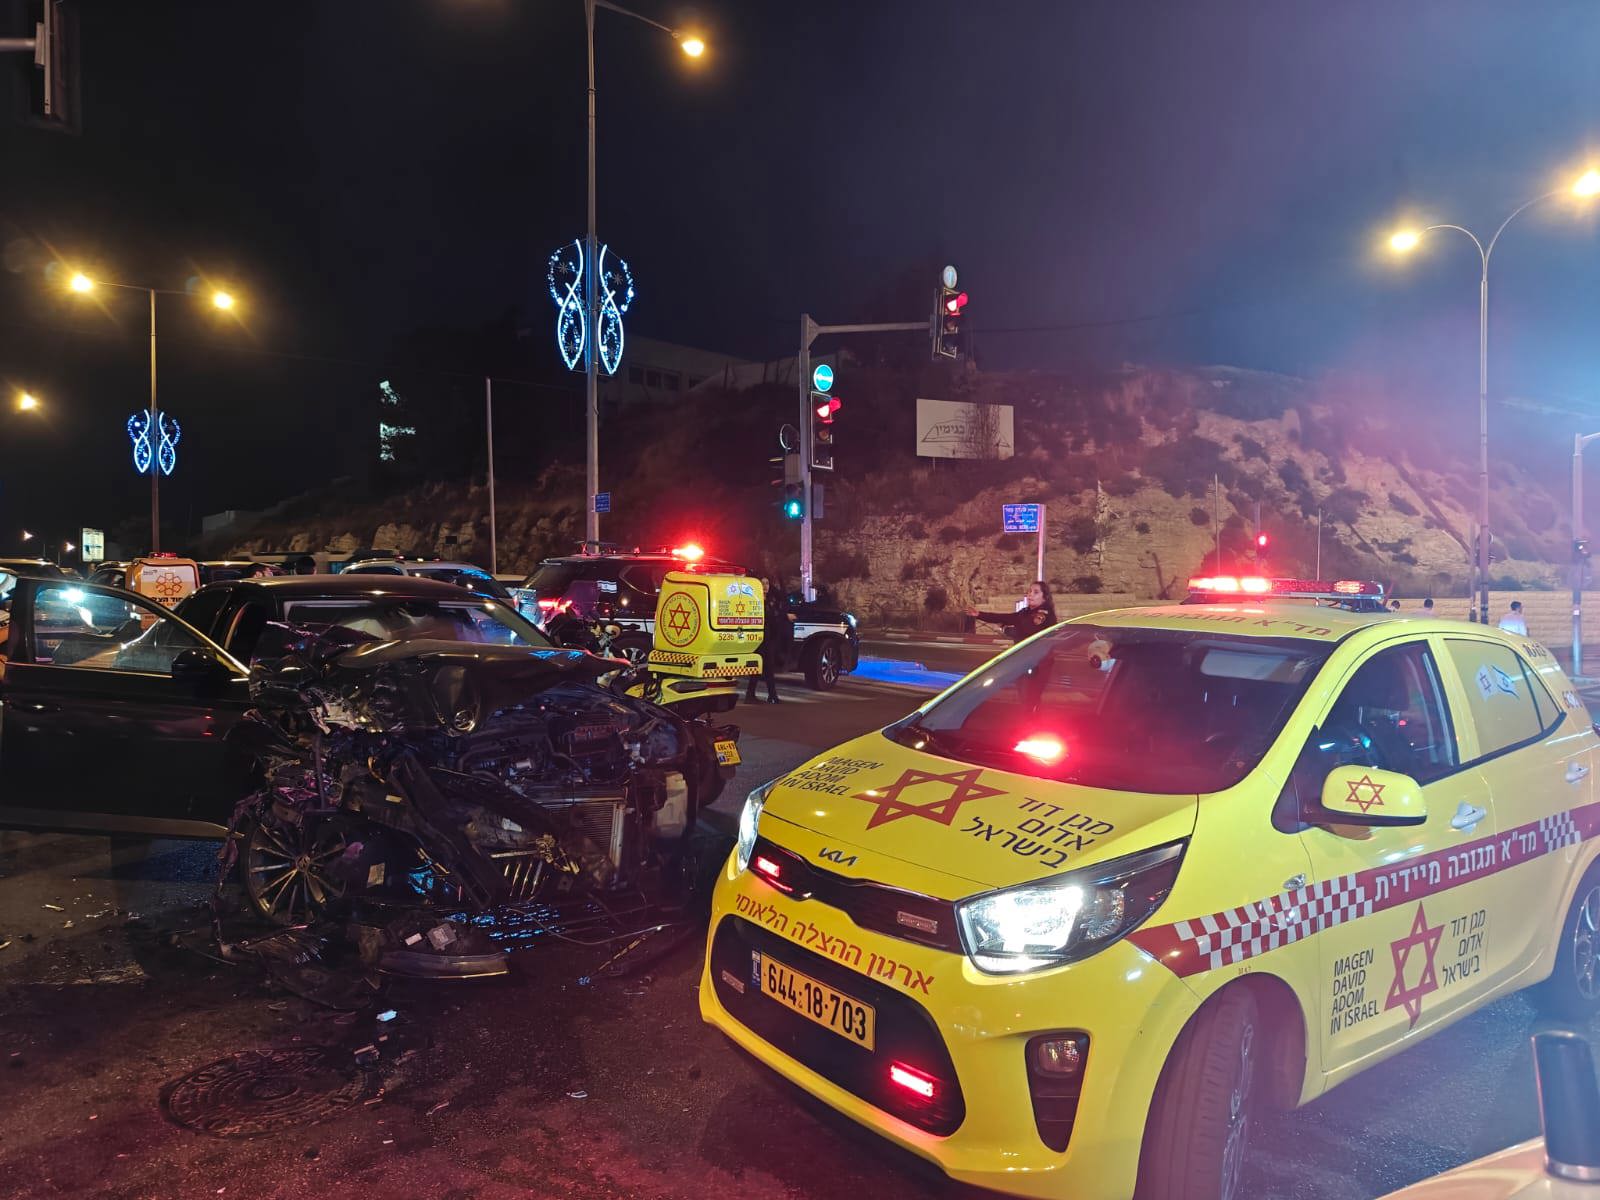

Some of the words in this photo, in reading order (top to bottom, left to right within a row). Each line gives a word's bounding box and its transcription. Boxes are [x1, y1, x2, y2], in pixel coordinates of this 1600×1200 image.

[795, 770, 847, 783] ADOM
[809, 764, 860, 775] DAVID
[827, 756, 884, 769] MAGEN
[779, 777, 802, 788] IN
[798, 780, 851, 796] ISRAEL
[1018, 796, 1064, 818] דוד
[1017, 818, 1096, 851] אדום
[1058, 813, 1115, 835] מגן
[818, 846, 859, 867] KIA
[960, 816, 1068, 869] בישראל
[1501, 830, 1537, 862] מד"א
[1447, 844, 1496, 880] תגובה
[1375, 863, 1441, 902] מיידית
[735, 893, 789, 933] הלאומי
[1450, 914, 1469, 938] דוד
[1468, 909, 1486, 934] מגן
[790, 920, 863, 967] ההצלה
[1458, 932, 1484, 957] אדום
[865, 952, 936, 995] ארגון
[1334, 948, 1375, 977] MAGEN
[1442, 954, 1481, 987] בישראל
[1333, 969, 1367, 997] DAVID
[1331, 988, 1365, 1017] ADOM
[1330, 1015, 1342, 1036] IN
[1344, 999, 1380, 1030] ISRAEL
